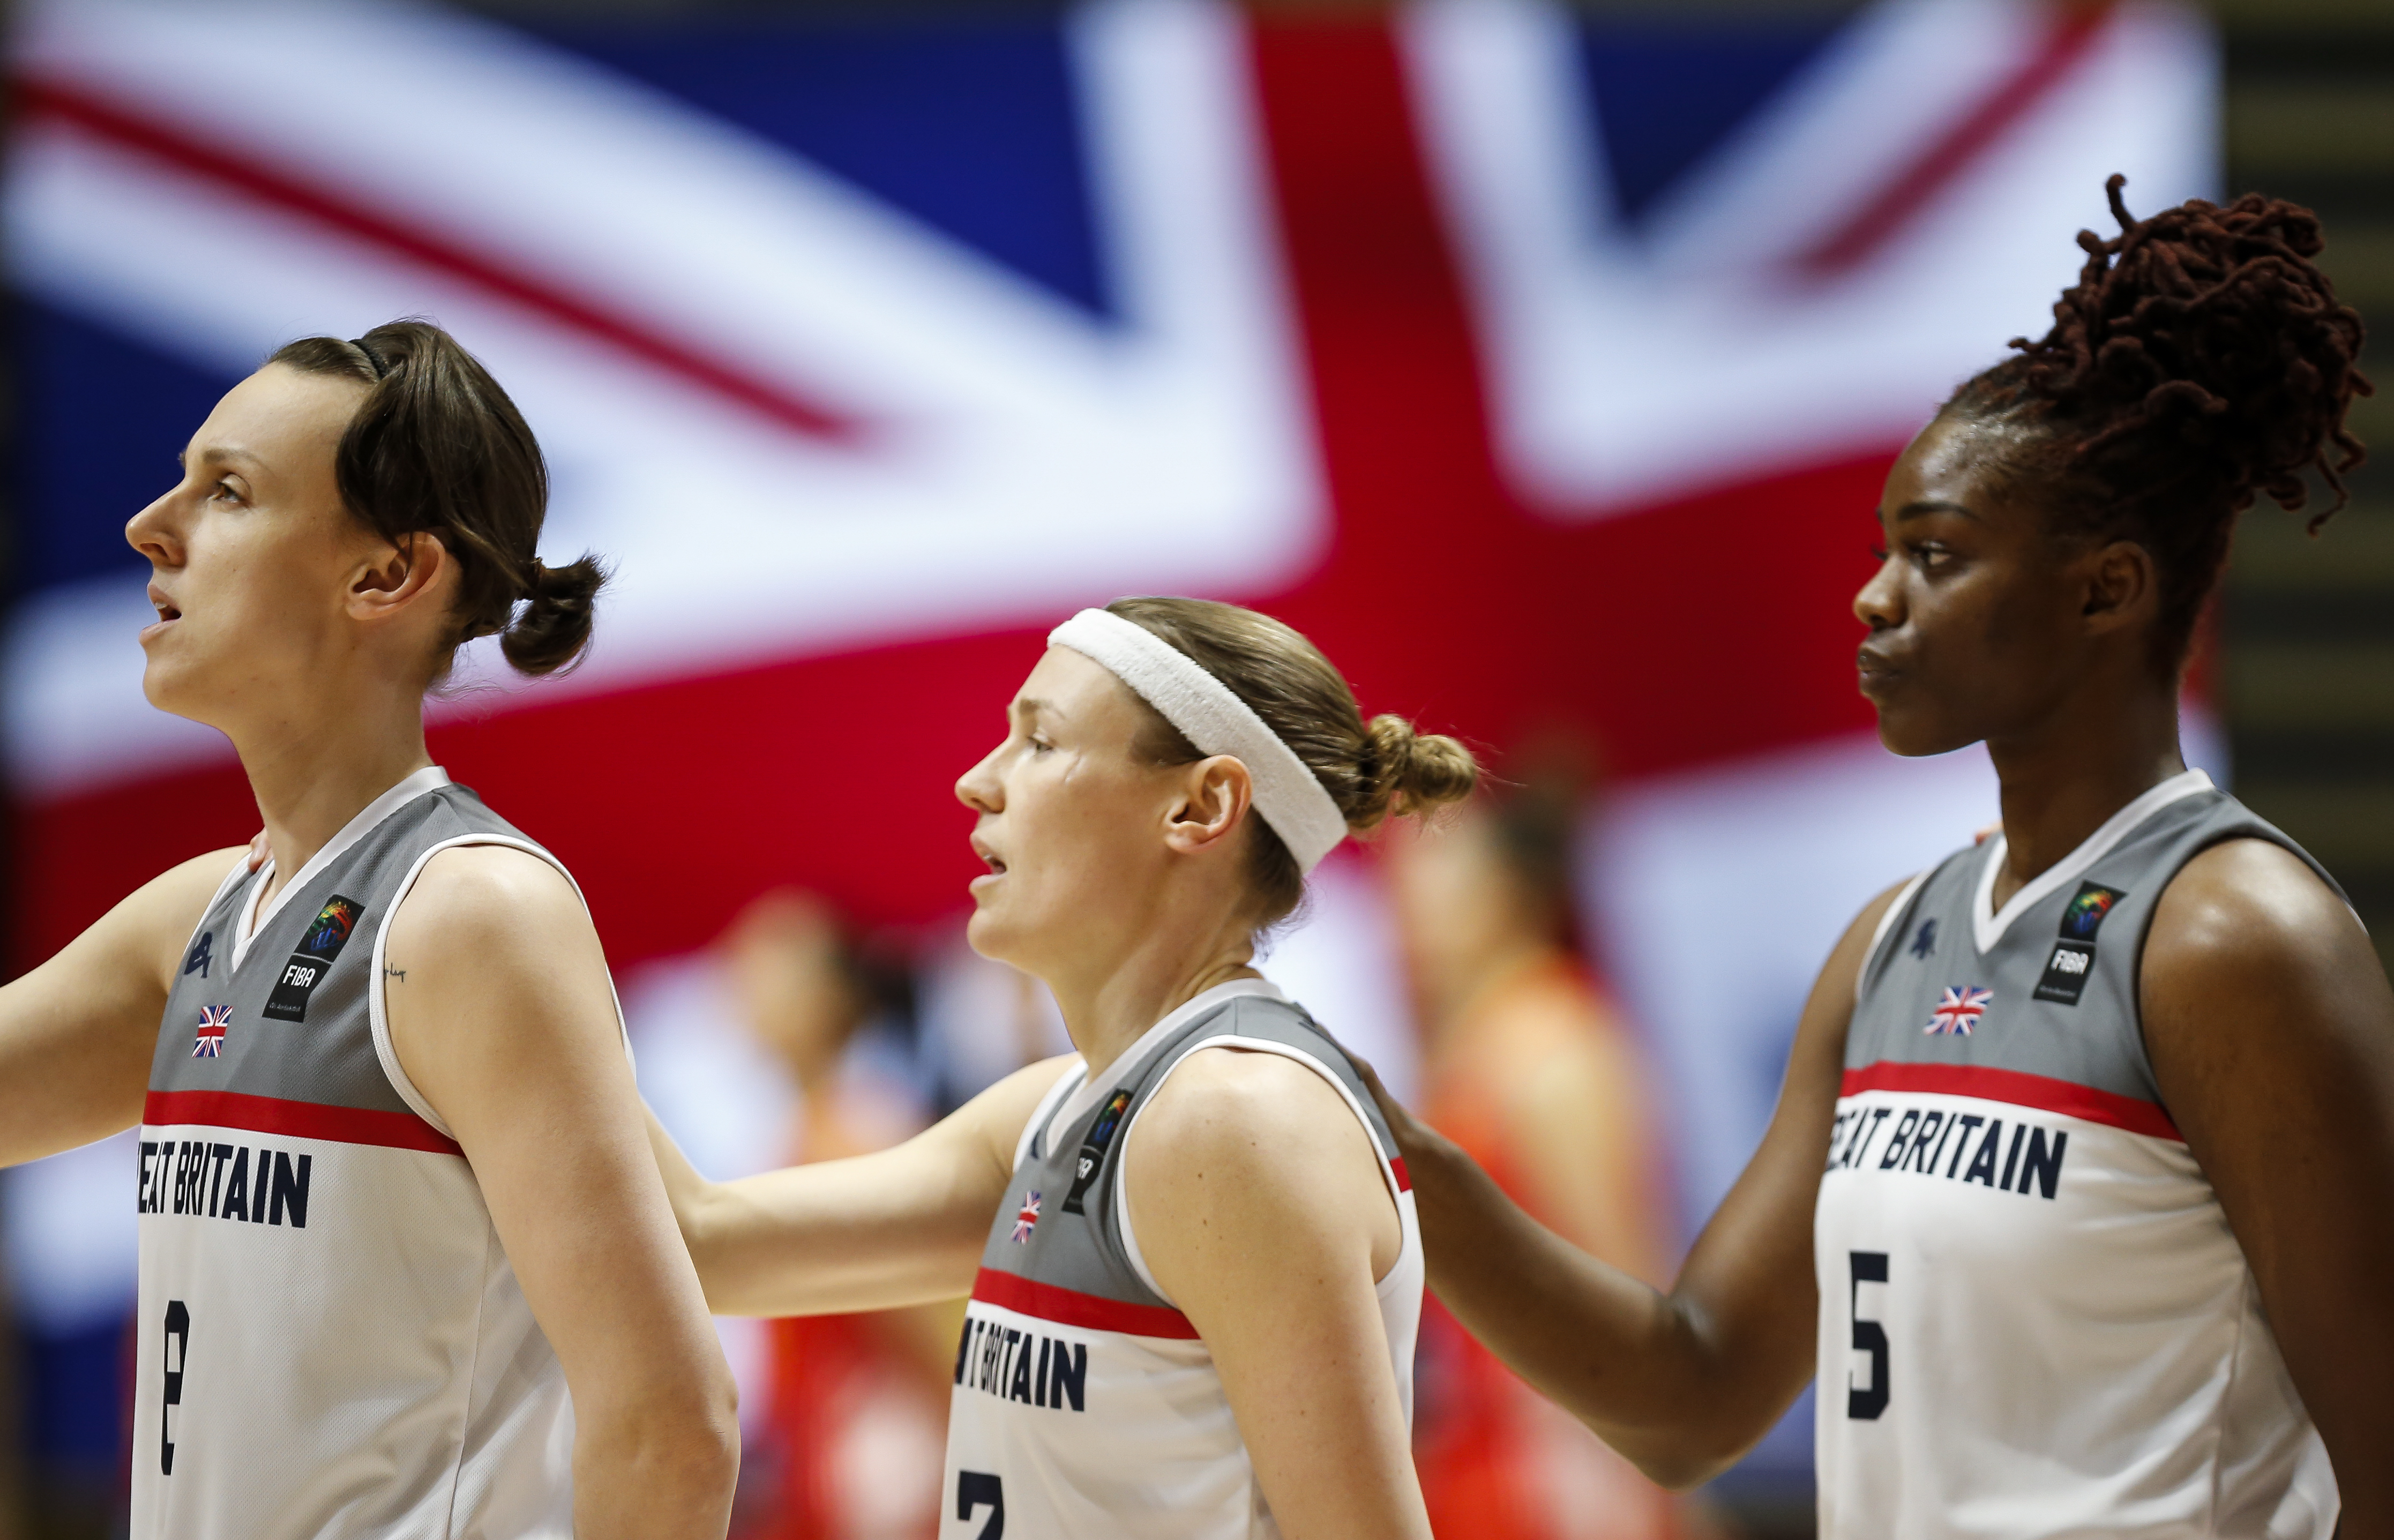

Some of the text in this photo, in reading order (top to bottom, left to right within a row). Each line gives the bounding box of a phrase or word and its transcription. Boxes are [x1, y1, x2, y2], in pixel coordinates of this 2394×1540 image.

[282, 965, 316, 988] FIBA
[137, 1141, 312, 1229] EAT BRITAIN
[1879, 1108, 2068, 1200] BRITAIN
[1848, 1250, 1890, 1421] 5
